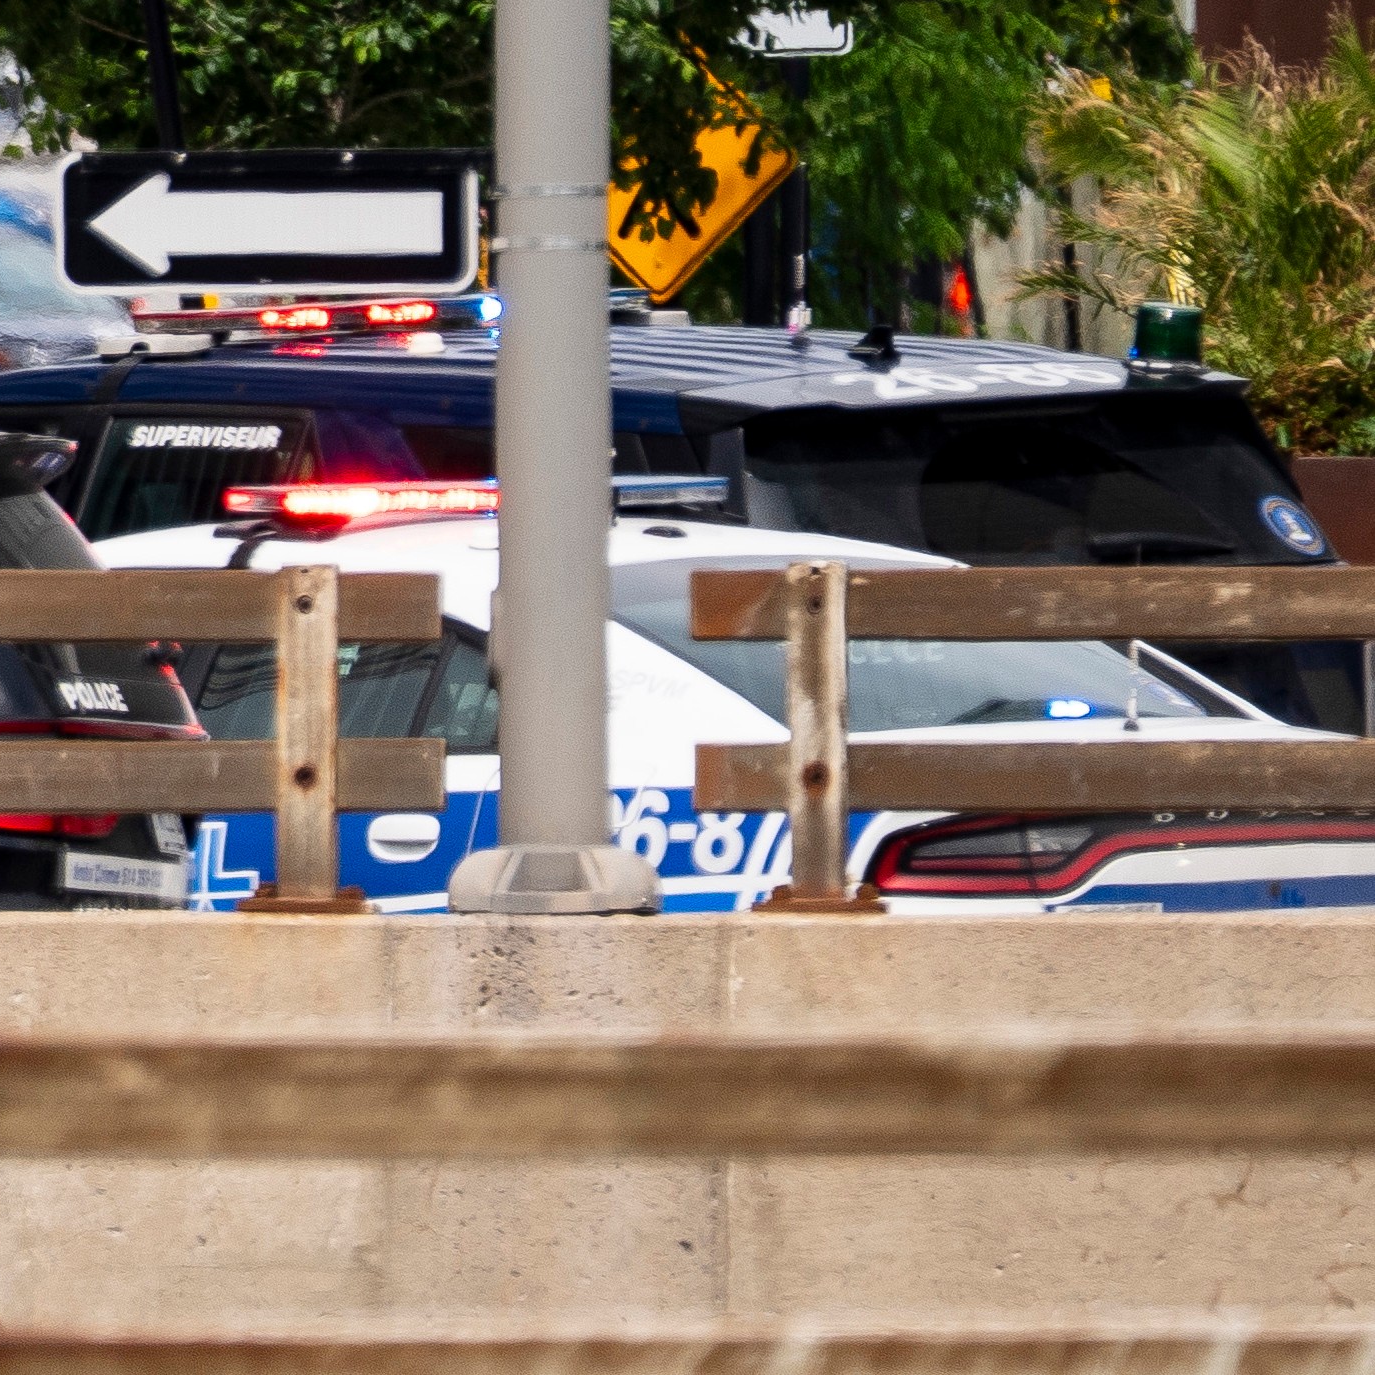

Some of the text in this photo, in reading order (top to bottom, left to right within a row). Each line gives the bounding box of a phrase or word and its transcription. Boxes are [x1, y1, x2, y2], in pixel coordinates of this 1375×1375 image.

[832, 362, 1123, 400] 26-86
[130, 425, 282, 450] SUPERVISEUR
[59, 682, 129, 712] POLICE
